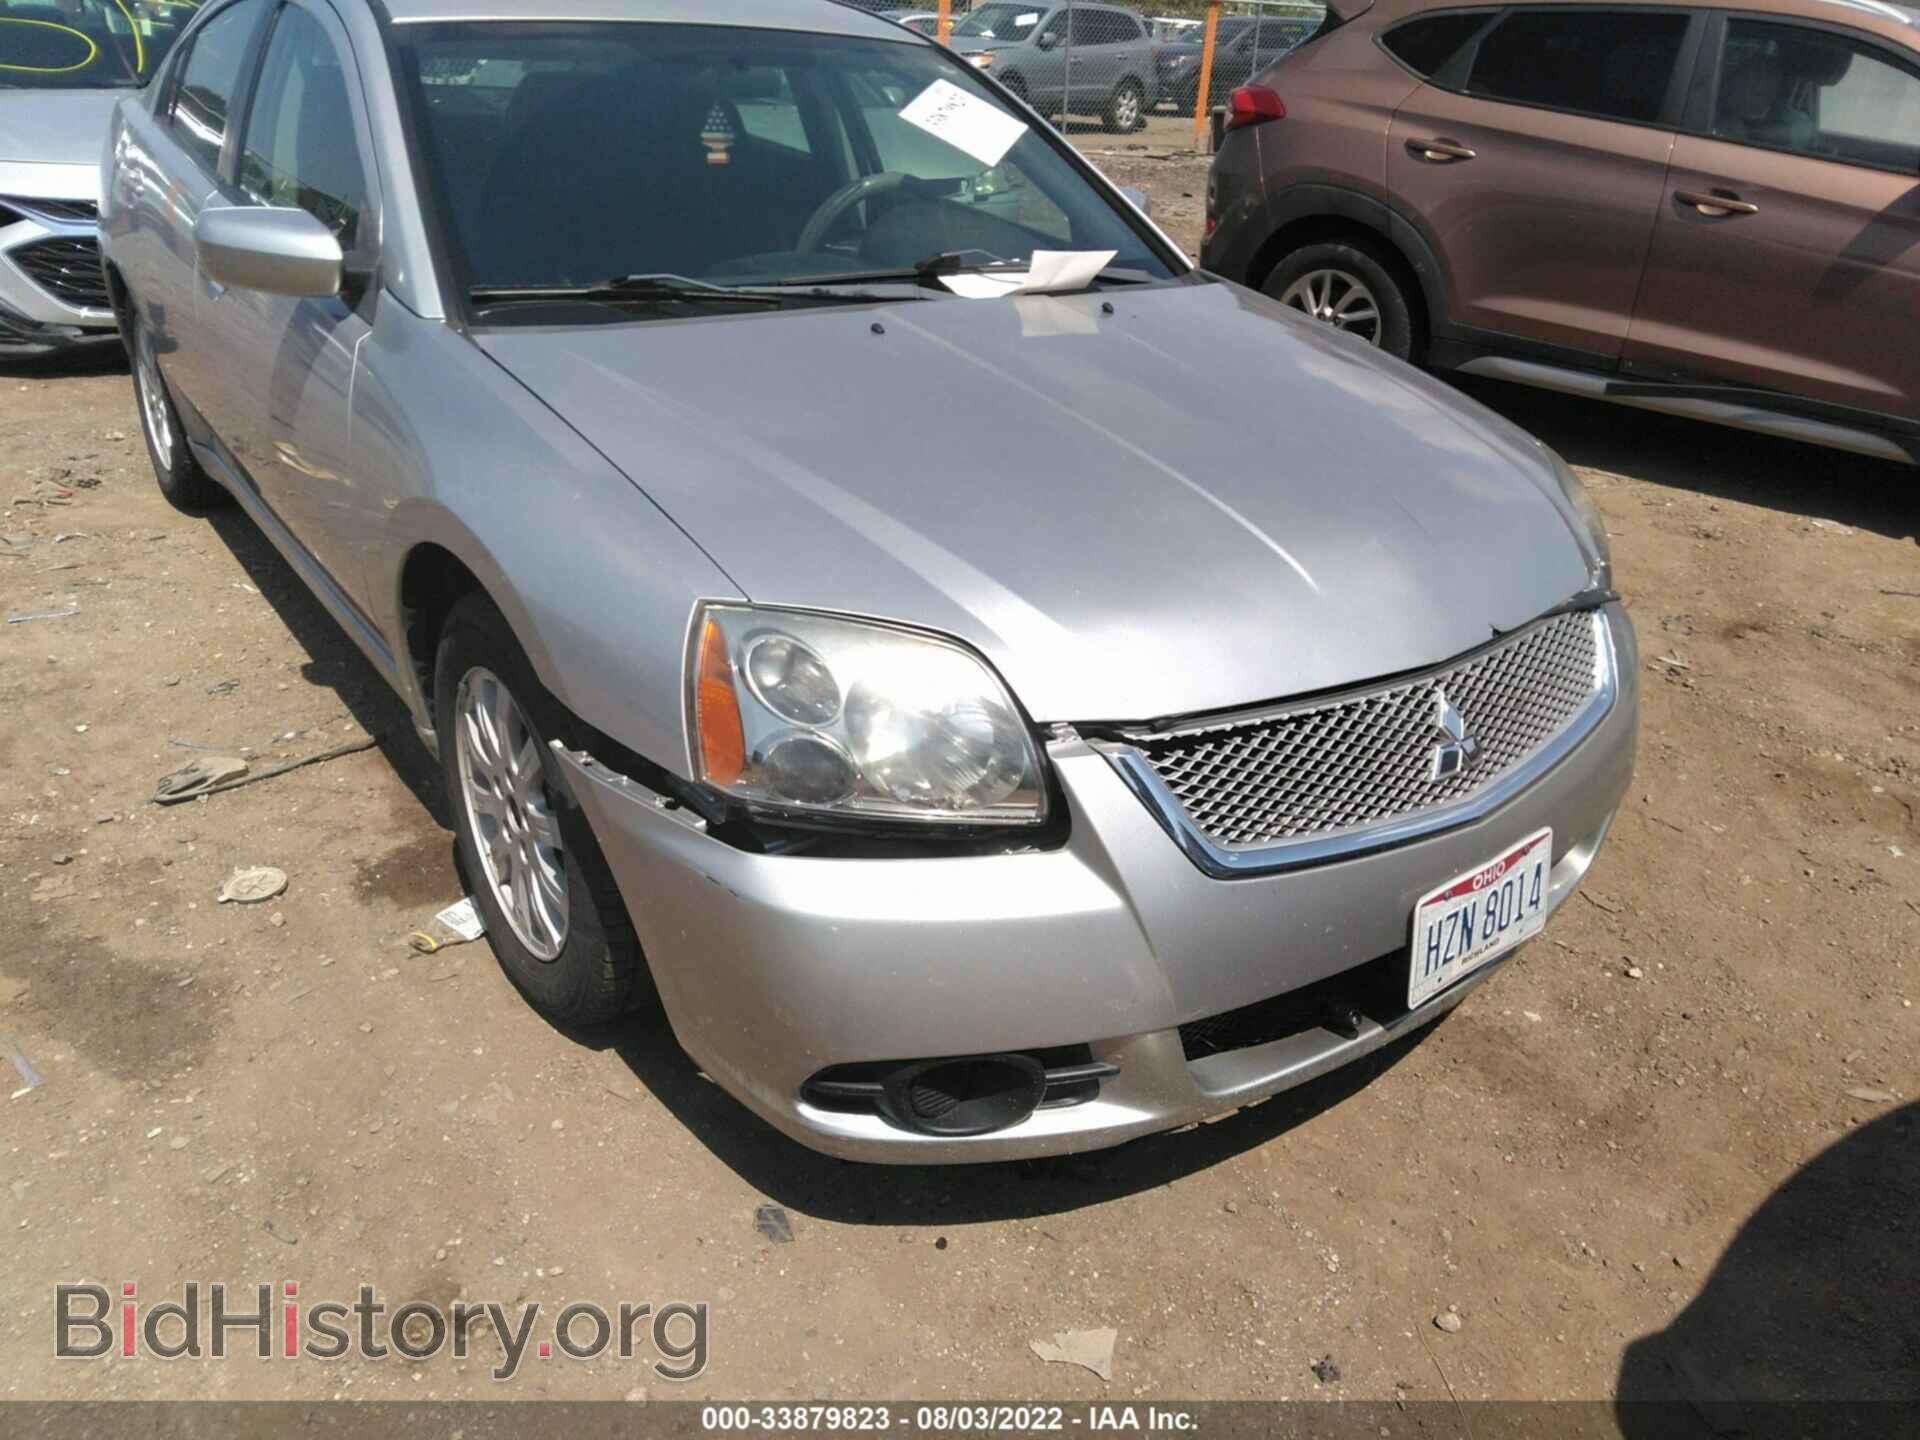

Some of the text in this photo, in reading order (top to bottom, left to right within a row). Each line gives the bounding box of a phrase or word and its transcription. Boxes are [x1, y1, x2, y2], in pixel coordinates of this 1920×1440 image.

[1472, 861, 1505, 890] OHIO
[1424, 863, 1543, 976] HZN 8014
